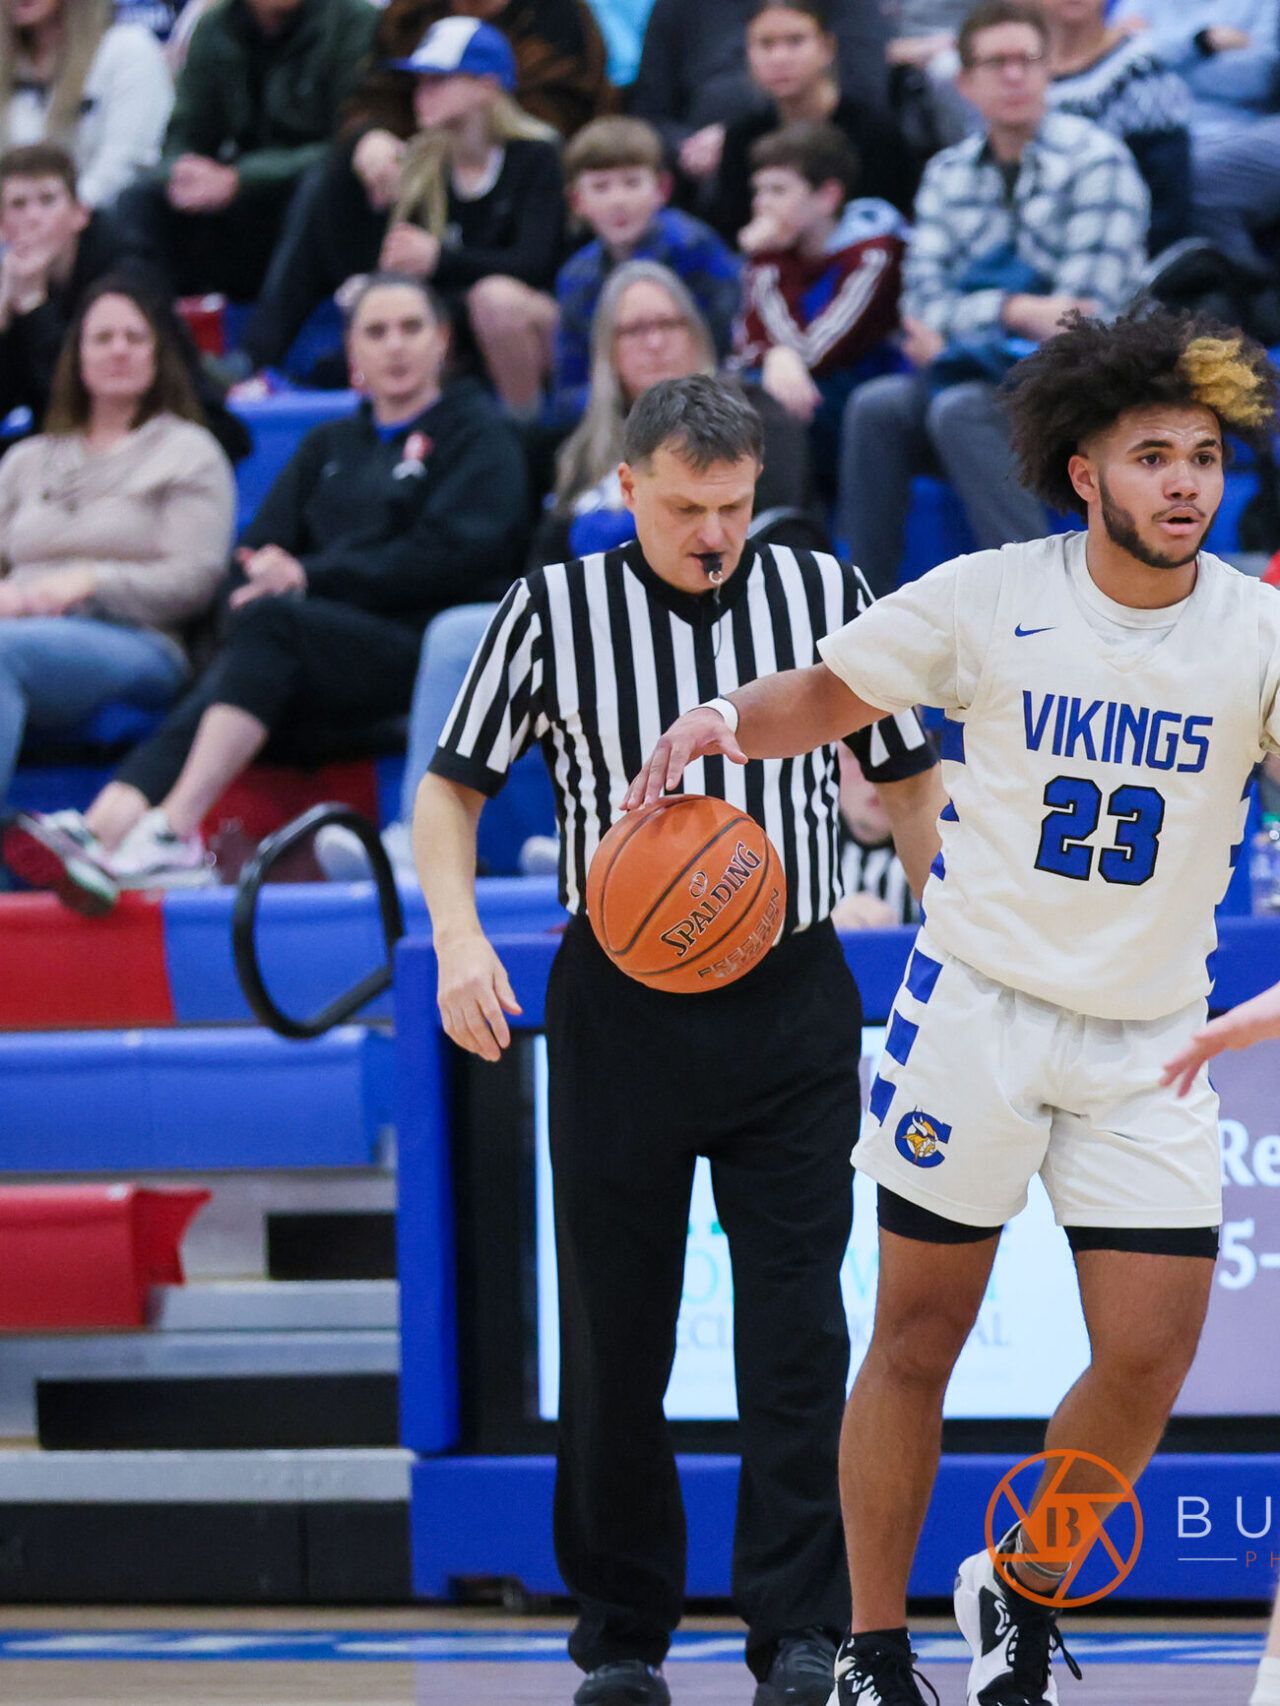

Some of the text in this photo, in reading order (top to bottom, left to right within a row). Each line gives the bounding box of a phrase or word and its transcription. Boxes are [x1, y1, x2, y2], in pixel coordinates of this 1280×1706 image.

[1022, 690, 1213, 773] VIKINGS
[1034, 775, 1166, 886] 23
[660, 840, 762, 957] SPALDING
